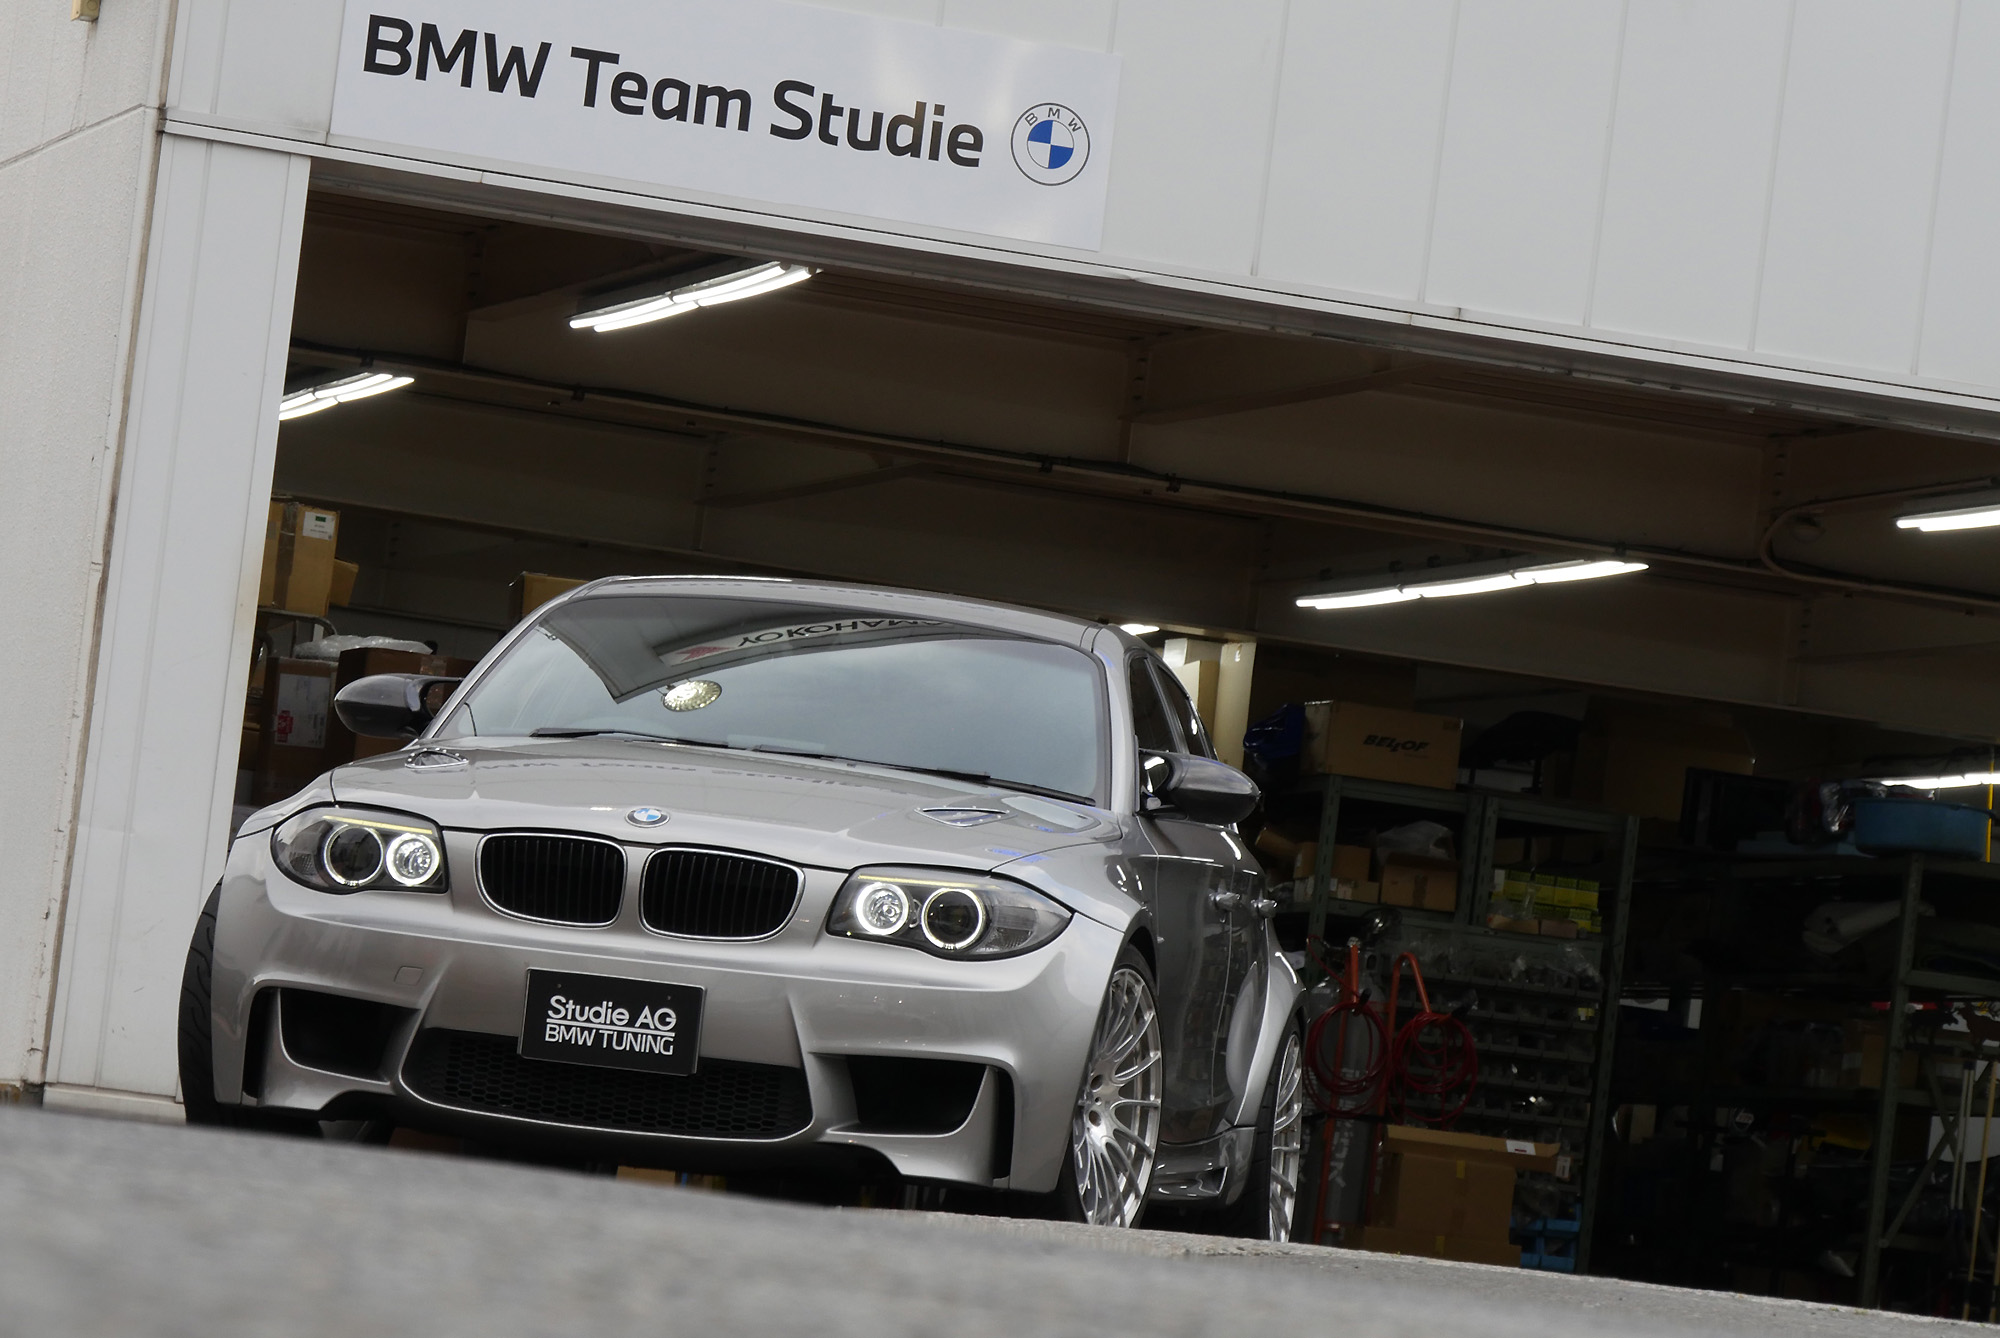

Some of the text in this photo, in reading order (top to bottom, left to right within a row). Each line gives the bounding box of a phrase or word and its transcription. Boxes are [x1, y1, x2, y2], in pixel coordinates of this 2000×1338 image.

[363, 13, 984, 168] BMW Team Studie
[1024, 107, 1082, 133] BMW
[547, 995, 677, 1031] Studie AG
[545, 1023, 674, 1056] BMW TUNING
